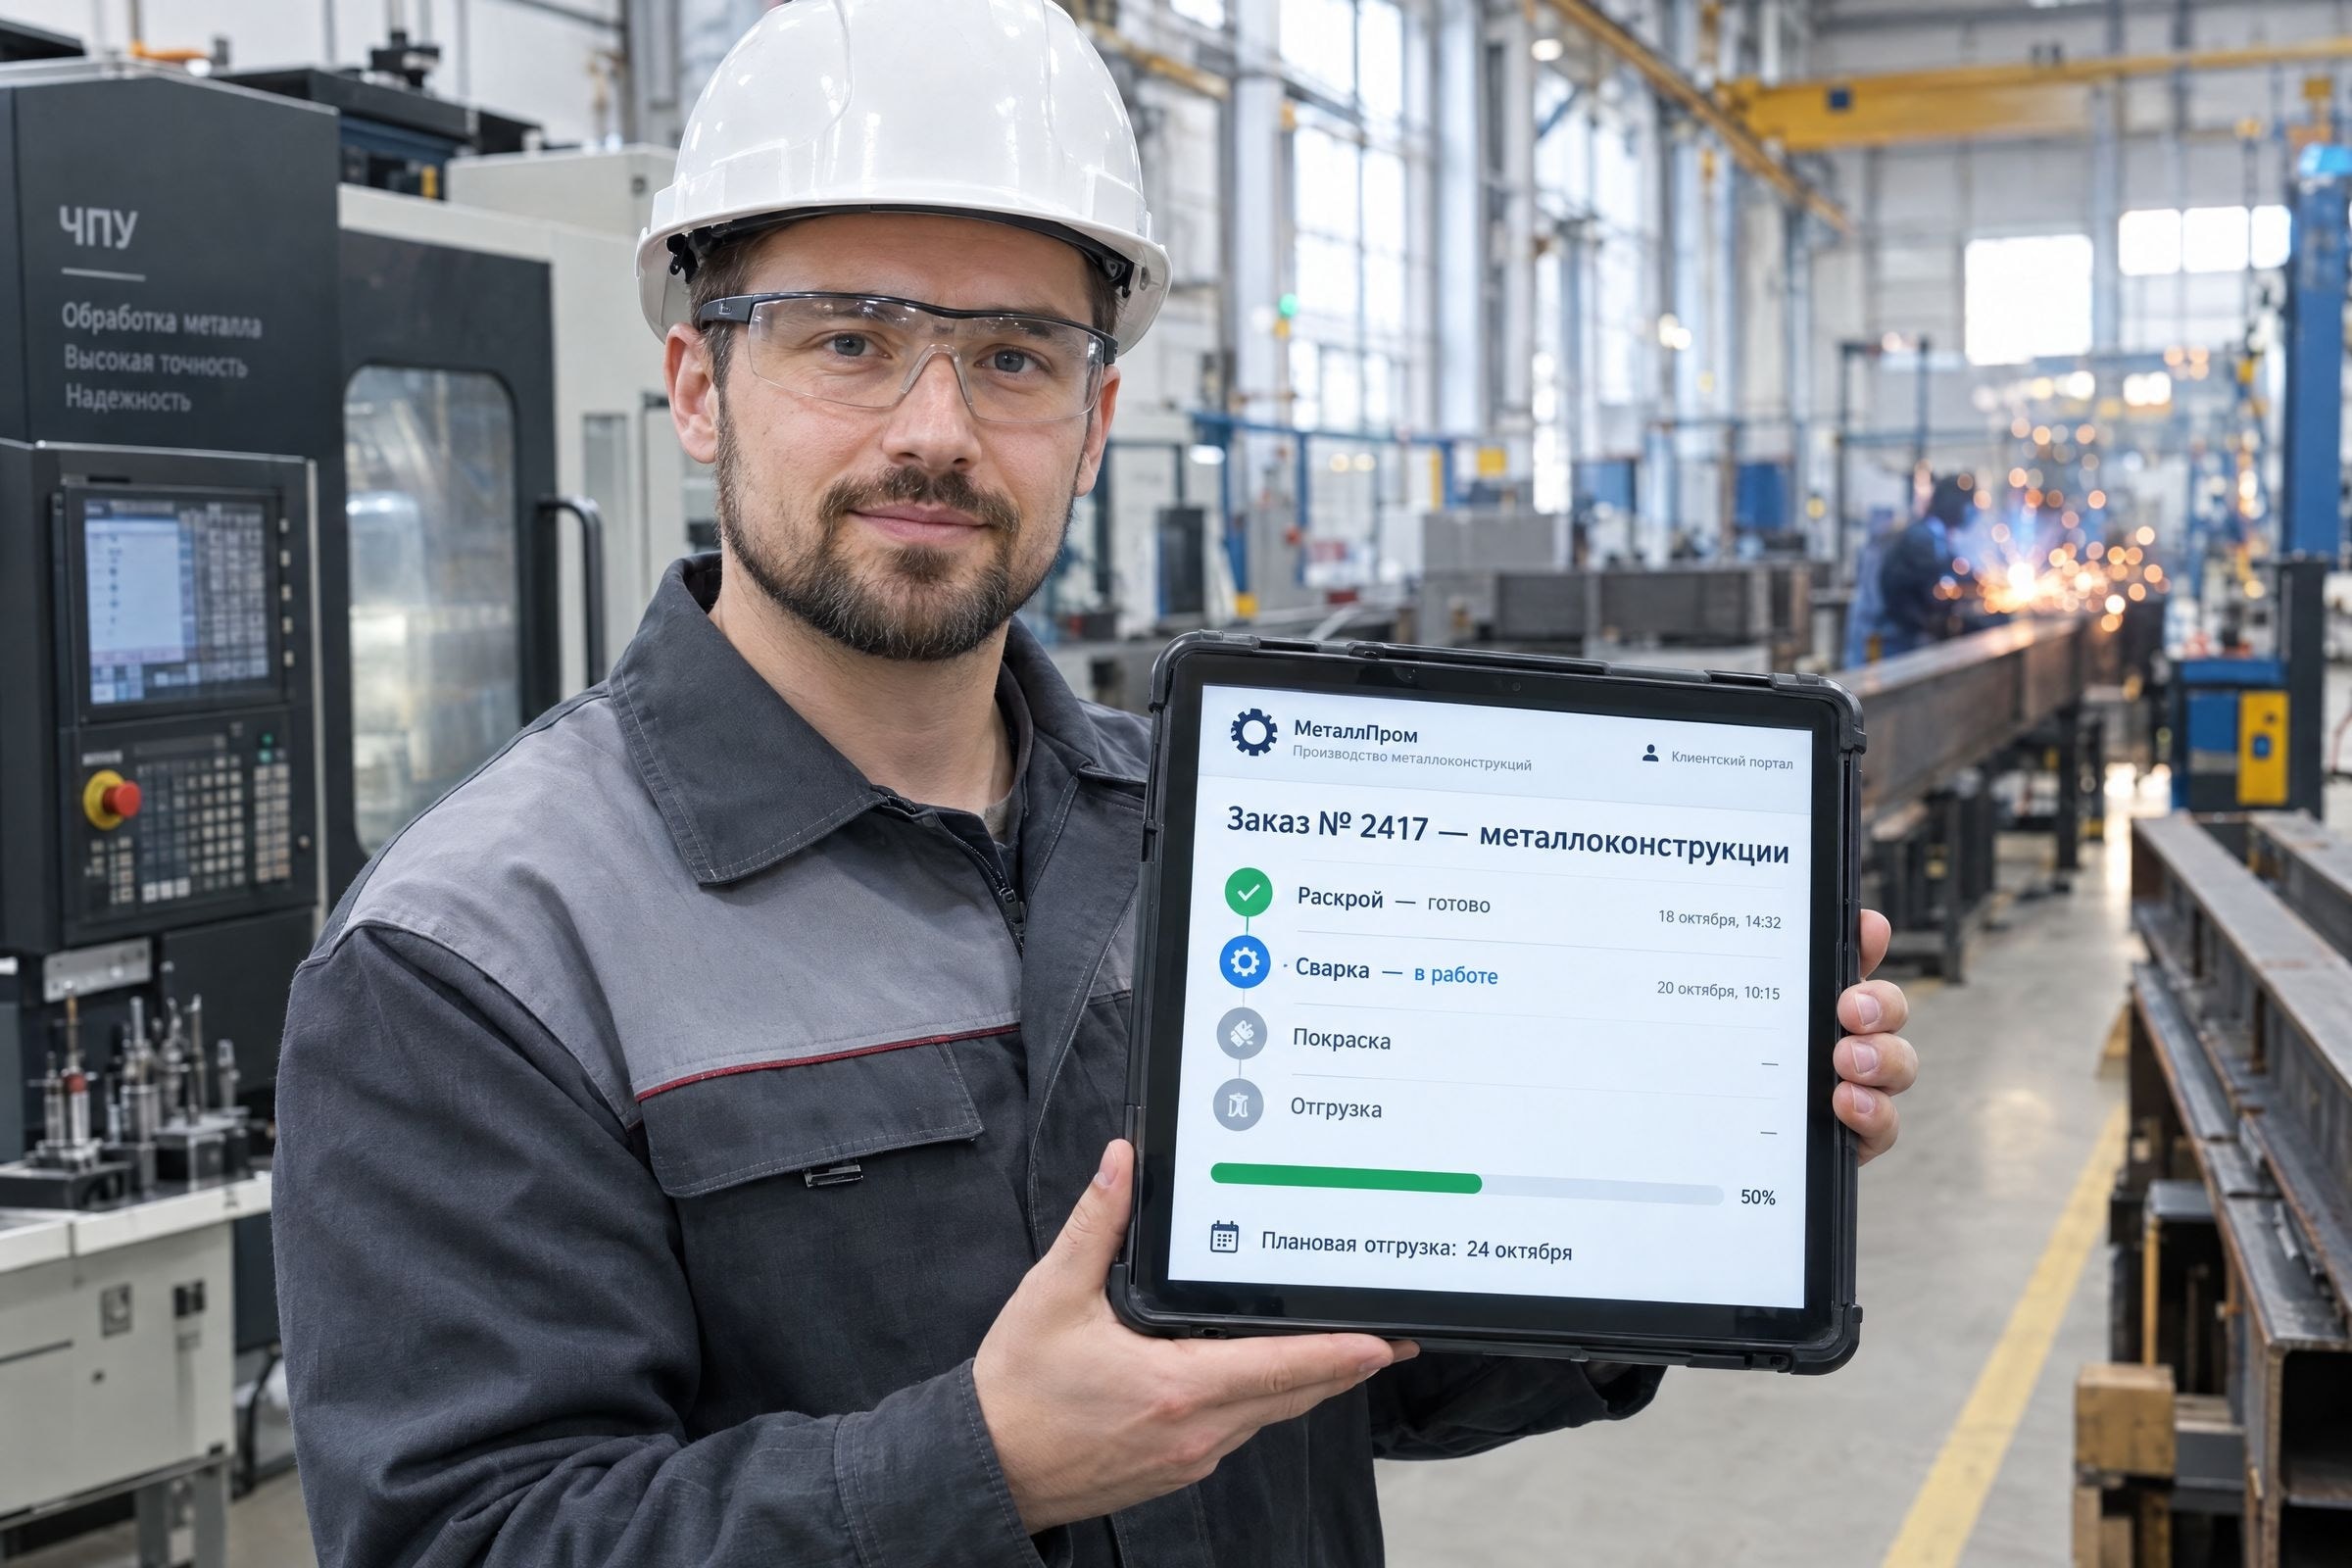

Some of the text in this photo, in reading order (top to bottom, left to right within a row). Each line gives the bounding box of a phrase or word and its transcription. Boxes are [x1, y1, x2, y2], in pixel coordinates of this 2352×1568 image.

[60, 206, 137, 249] ЧПУ
[63, 302, 262, 338] Обработка металла
[65, 344, 248, 378] Высокая точность
[67, 383, 191, 412] Надежность
[1295, 719, 1417, 744] МеталлПром
[1294, 745, 1532, 771] Производство металлоконструкций
[1672, 751, 1792, 770] Клиентский портал
[1227, 806, 1309, 834] Заказ
[1319, 811, 1351, 836] №
[1360, 813, 1428, 841] 2417
[1481, 827, 1788, 866] металлоконструкции
[1298, 887, 1383, 910] Раскрой
[1429, 898, 1490, 912] готово
[1659, 910, 1781, 929] 18 октября, 14:32
[1297, 957, 1369, 981] Сварка
[1415, 968, 1425, 980] в
[1432, 966, 1497, 986] работе
[1657, 981, 1780, 1000] 20 октября, 10:15
[1294, 1028, 1391, 1052] Покраска
[1292, 1098, 1382, 1120] Отгрузка
[1741, 1190, 1776, 1205] 50%
[1262, 1231, 1572, 1264] Плановая отгрузка: 24 октября
